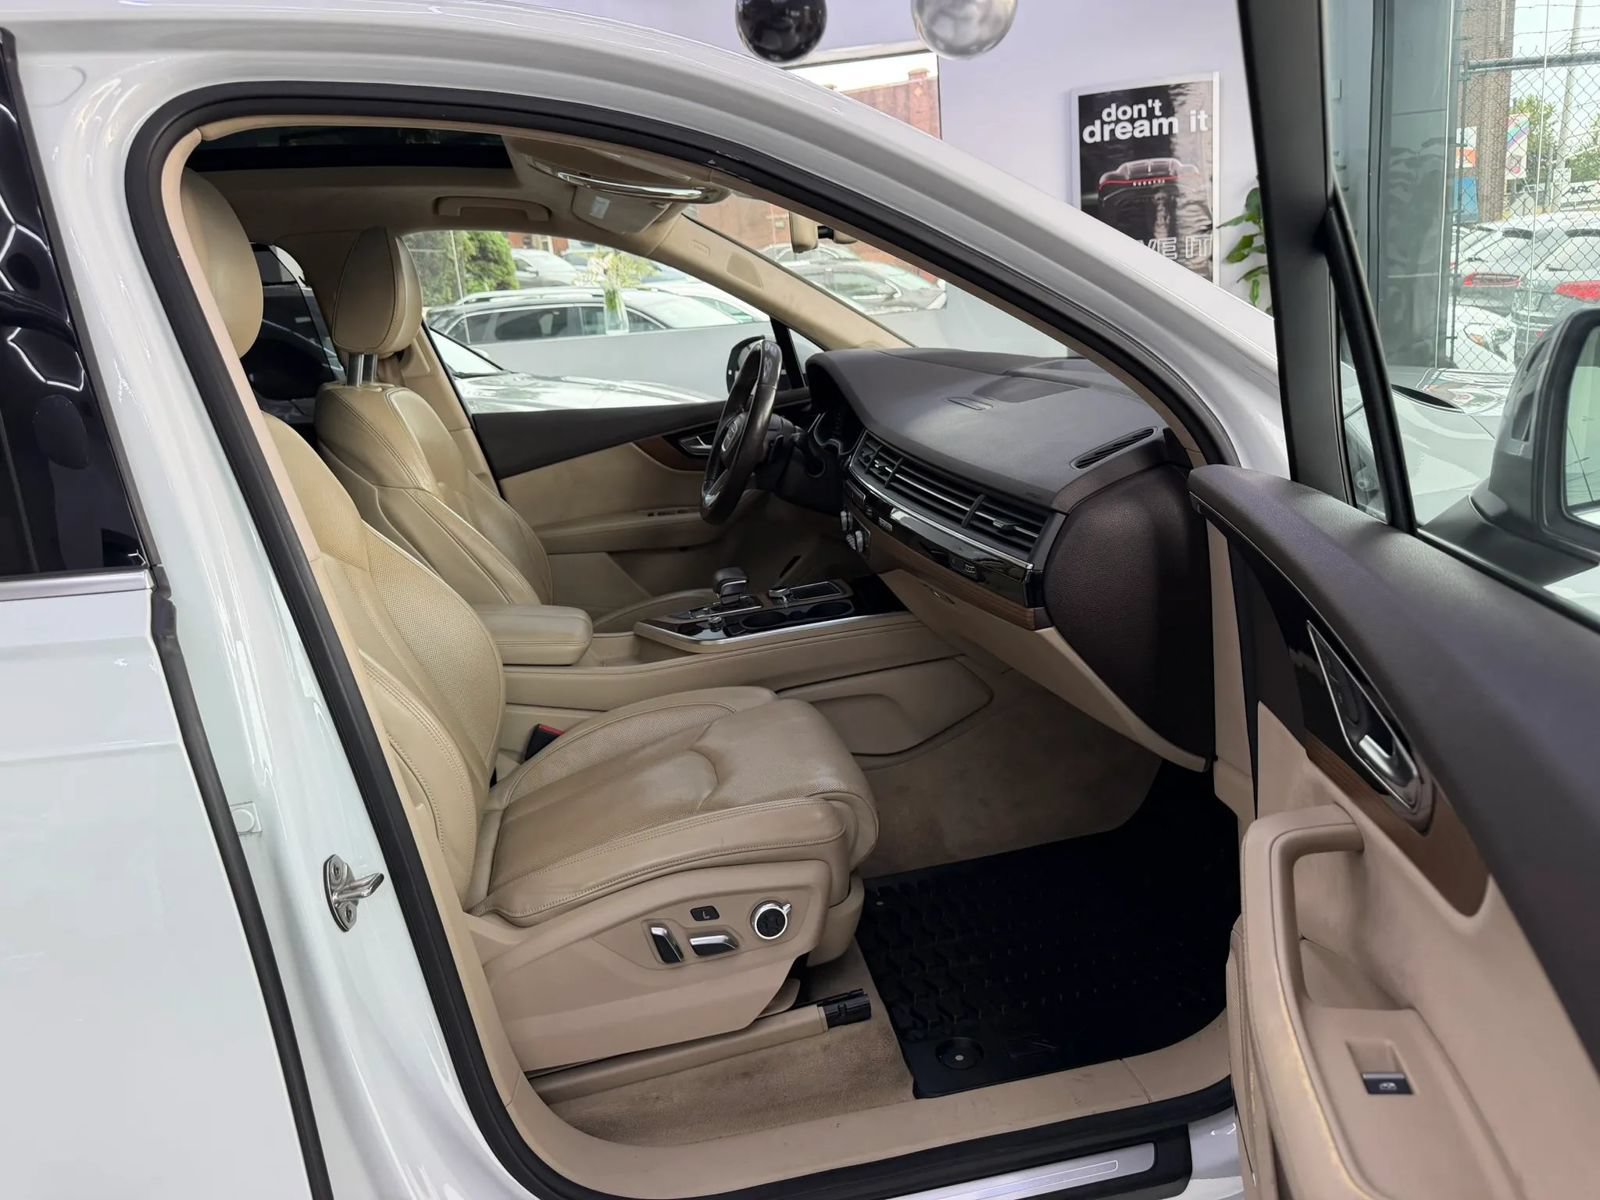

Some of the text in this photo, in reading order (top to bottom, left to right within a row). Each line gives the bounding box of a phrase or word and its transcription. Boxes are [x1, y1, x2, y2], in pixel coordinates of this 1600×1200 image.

[1101, 99, 1162, 122] don't
[1082, 109, 1208, 144] dream it
[1185, 234, 1213, 259] IT
